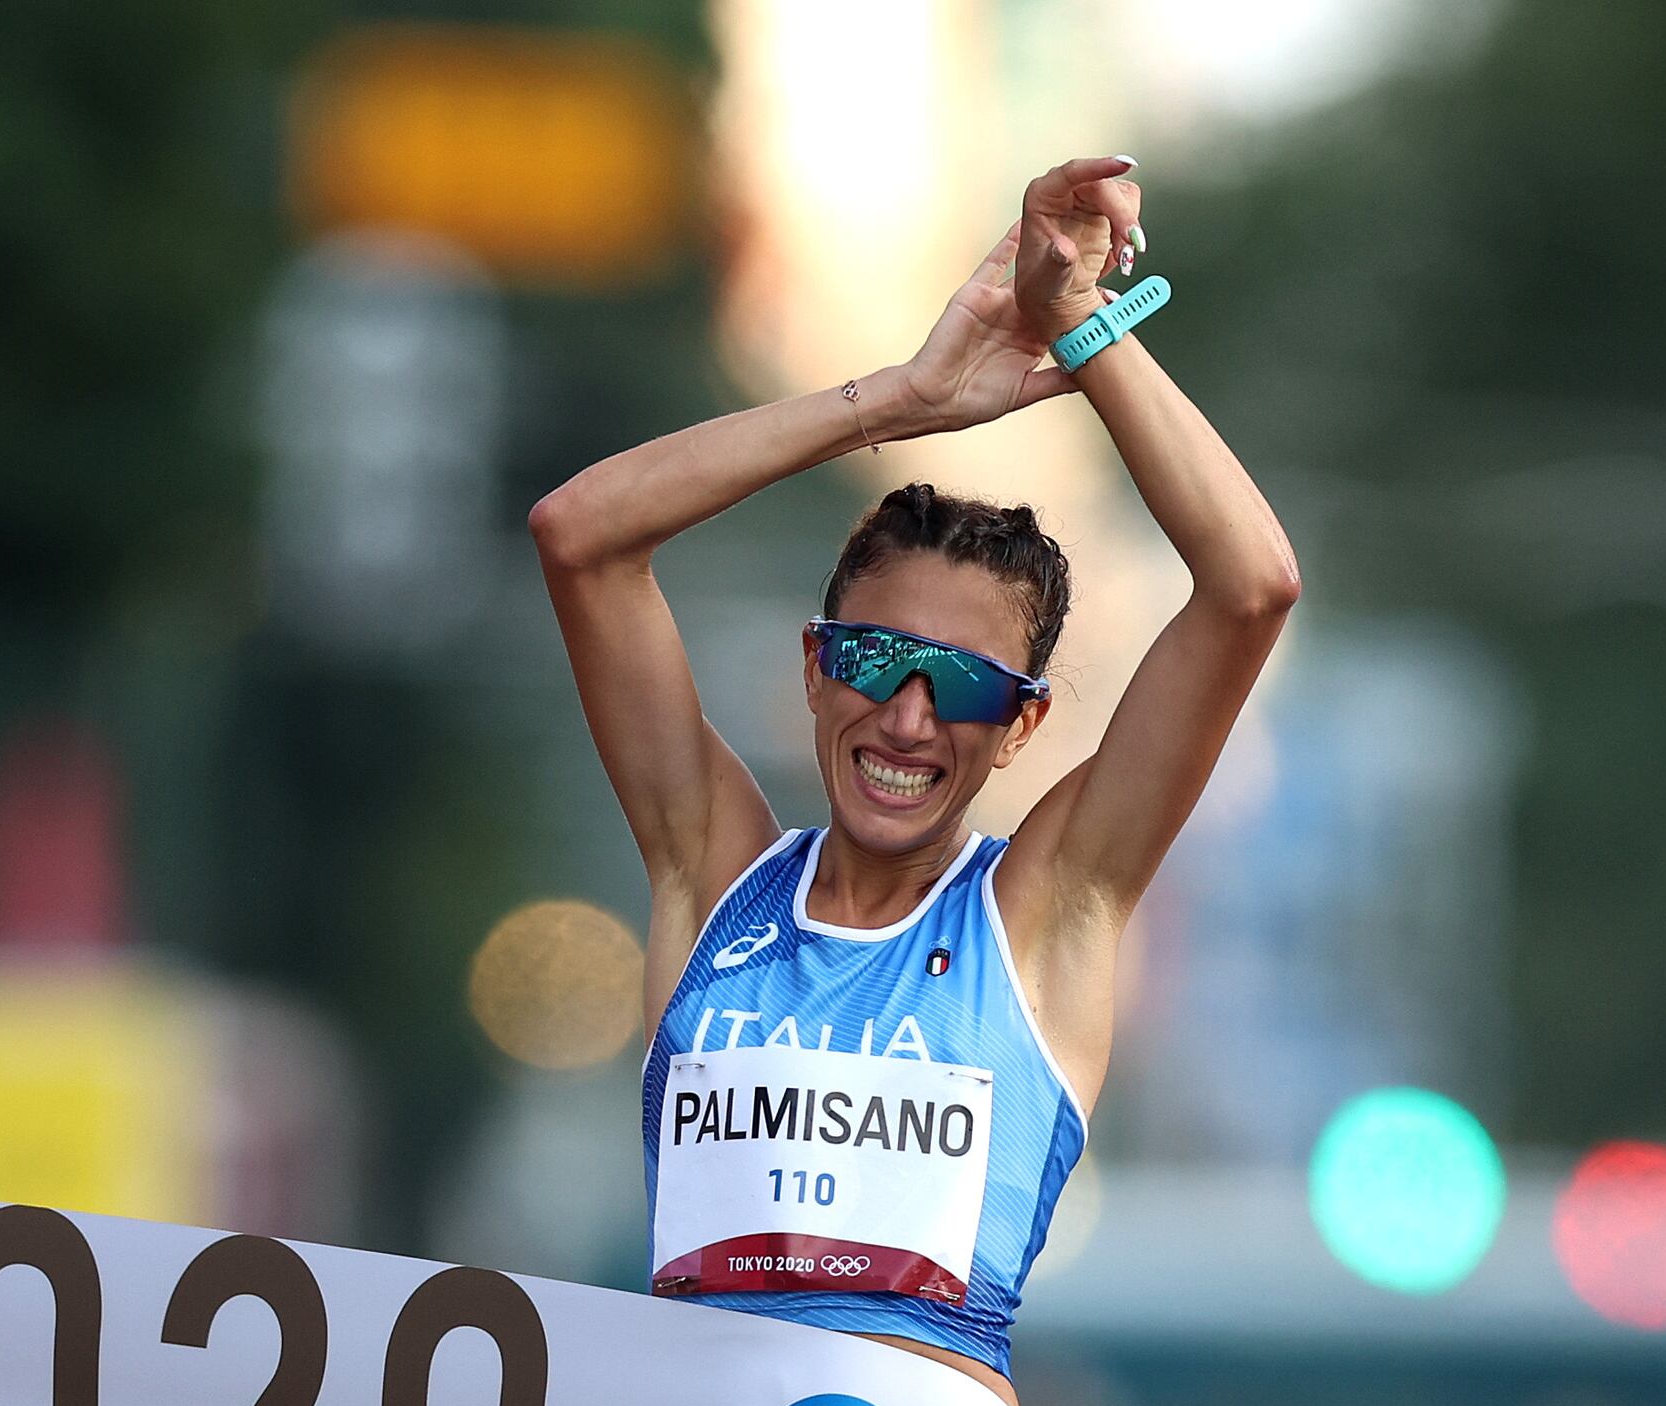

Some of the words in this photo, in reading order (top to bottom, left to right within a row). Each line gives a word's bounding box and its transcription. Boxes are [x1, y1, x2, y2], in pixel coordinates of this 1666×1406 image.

[673, 1086, 974, 1157] PALMISANO
[768, 1168, 836, 1206] 110
[727, 1256, 773, 1272] TOKYO
[775, 1256, 815, 1273] 2020
